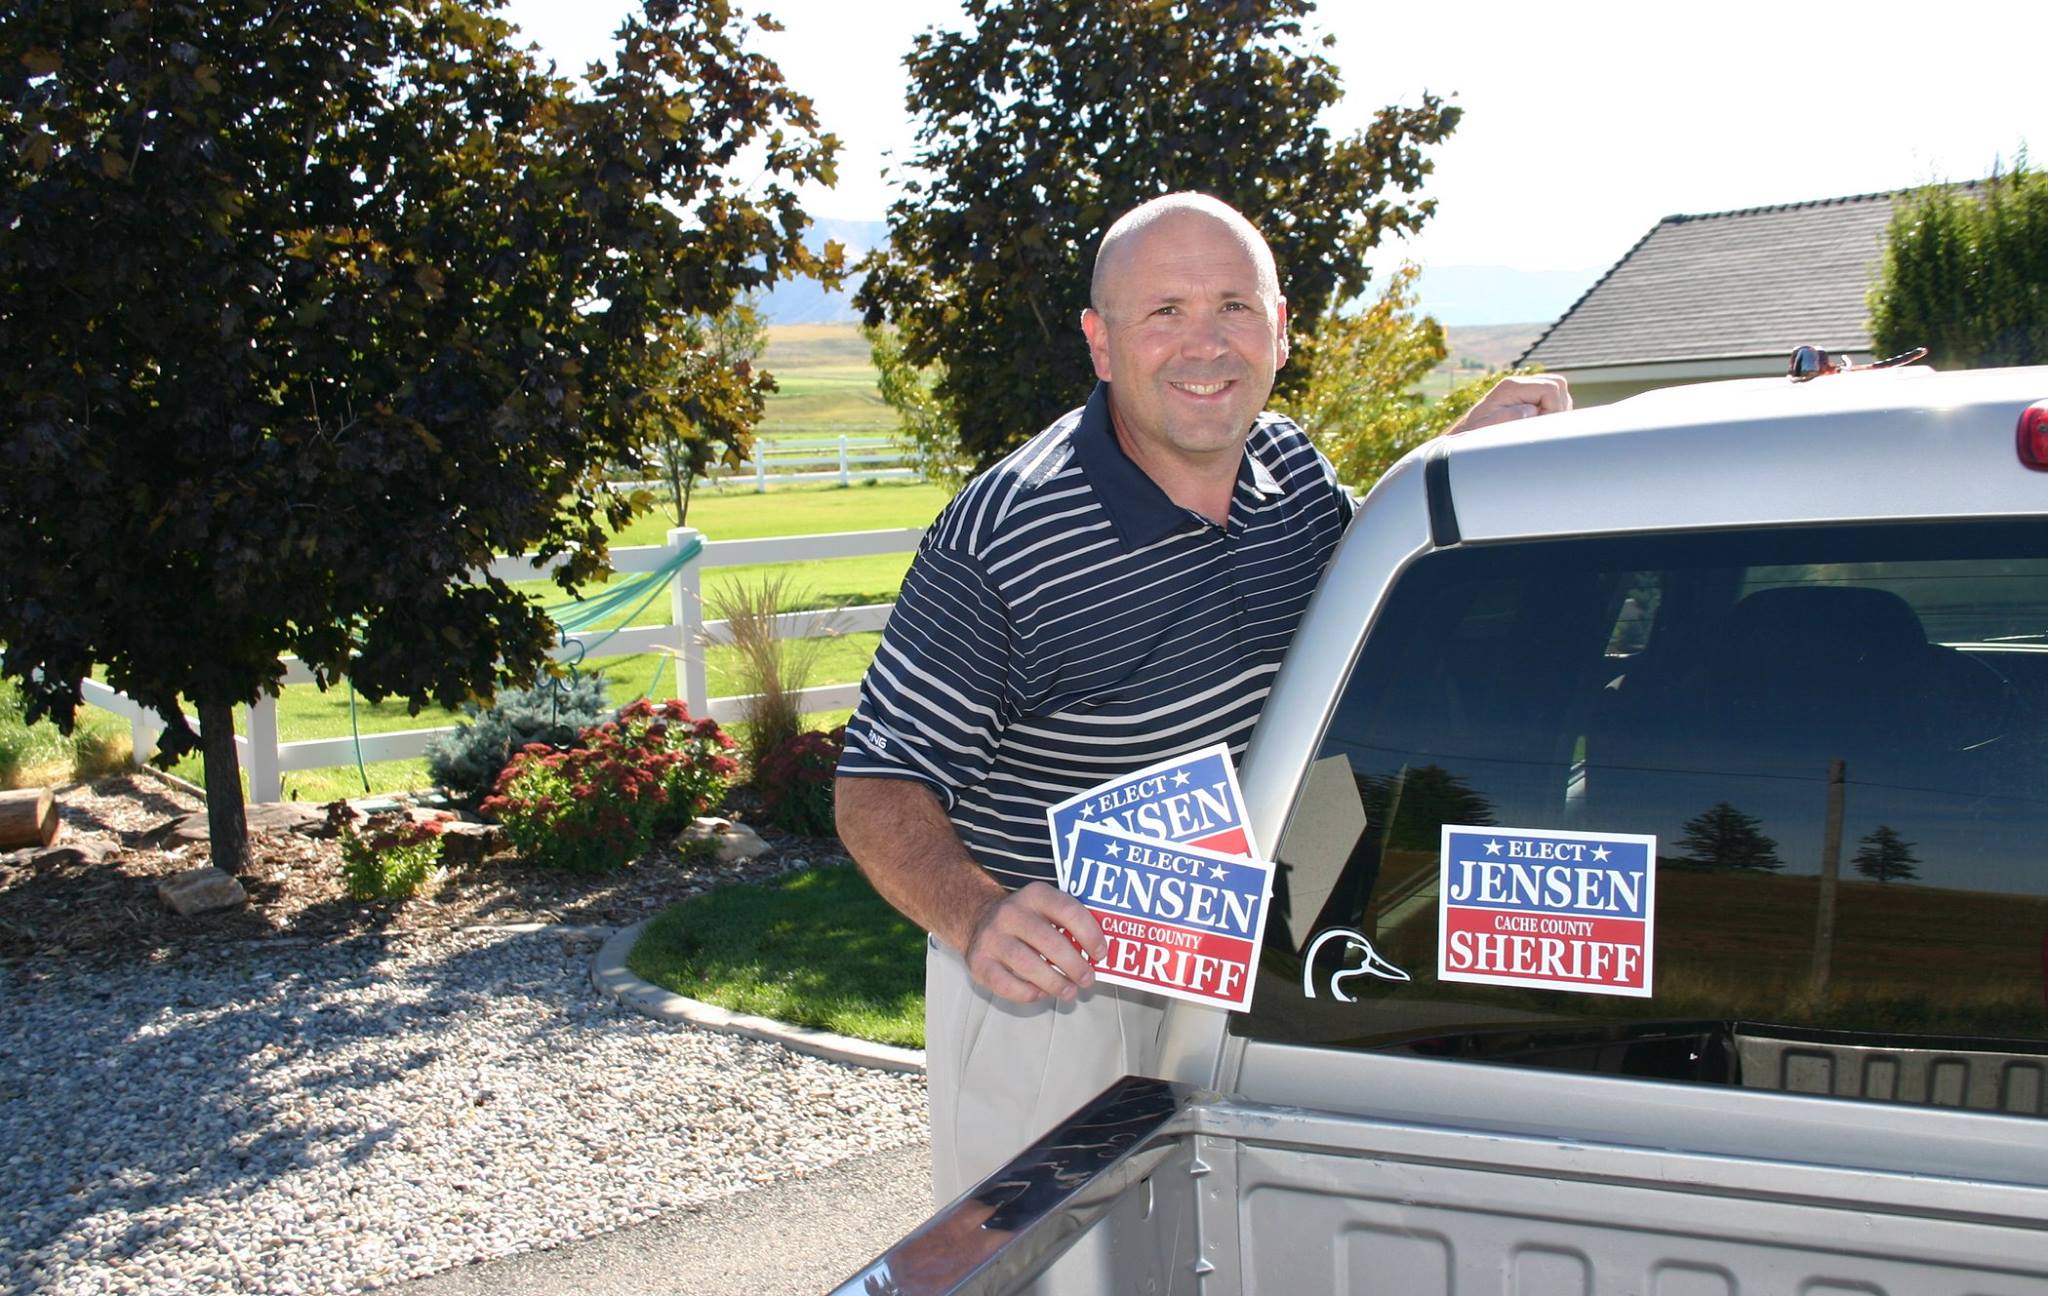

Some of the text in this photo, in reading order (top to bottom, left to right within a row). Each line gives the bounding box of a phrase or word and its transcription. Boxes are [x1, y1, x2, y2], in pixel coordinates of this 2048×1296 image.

[1099, 775, 1167, 814] ELECT
[1126, 844, 1205, 877] ELECT
[1508, 840, 1587, 861] ELECT
[1070, 857, 1259, 934] JENSEN
[1450, 860, 1644, 913] JENSEN
[1102, 917, 1203, 950] CACHE COUNTY
[1495, 915, 1594, 937] CACHE COUNTY
[1449, 930, 1641, 983] SHERIFF
